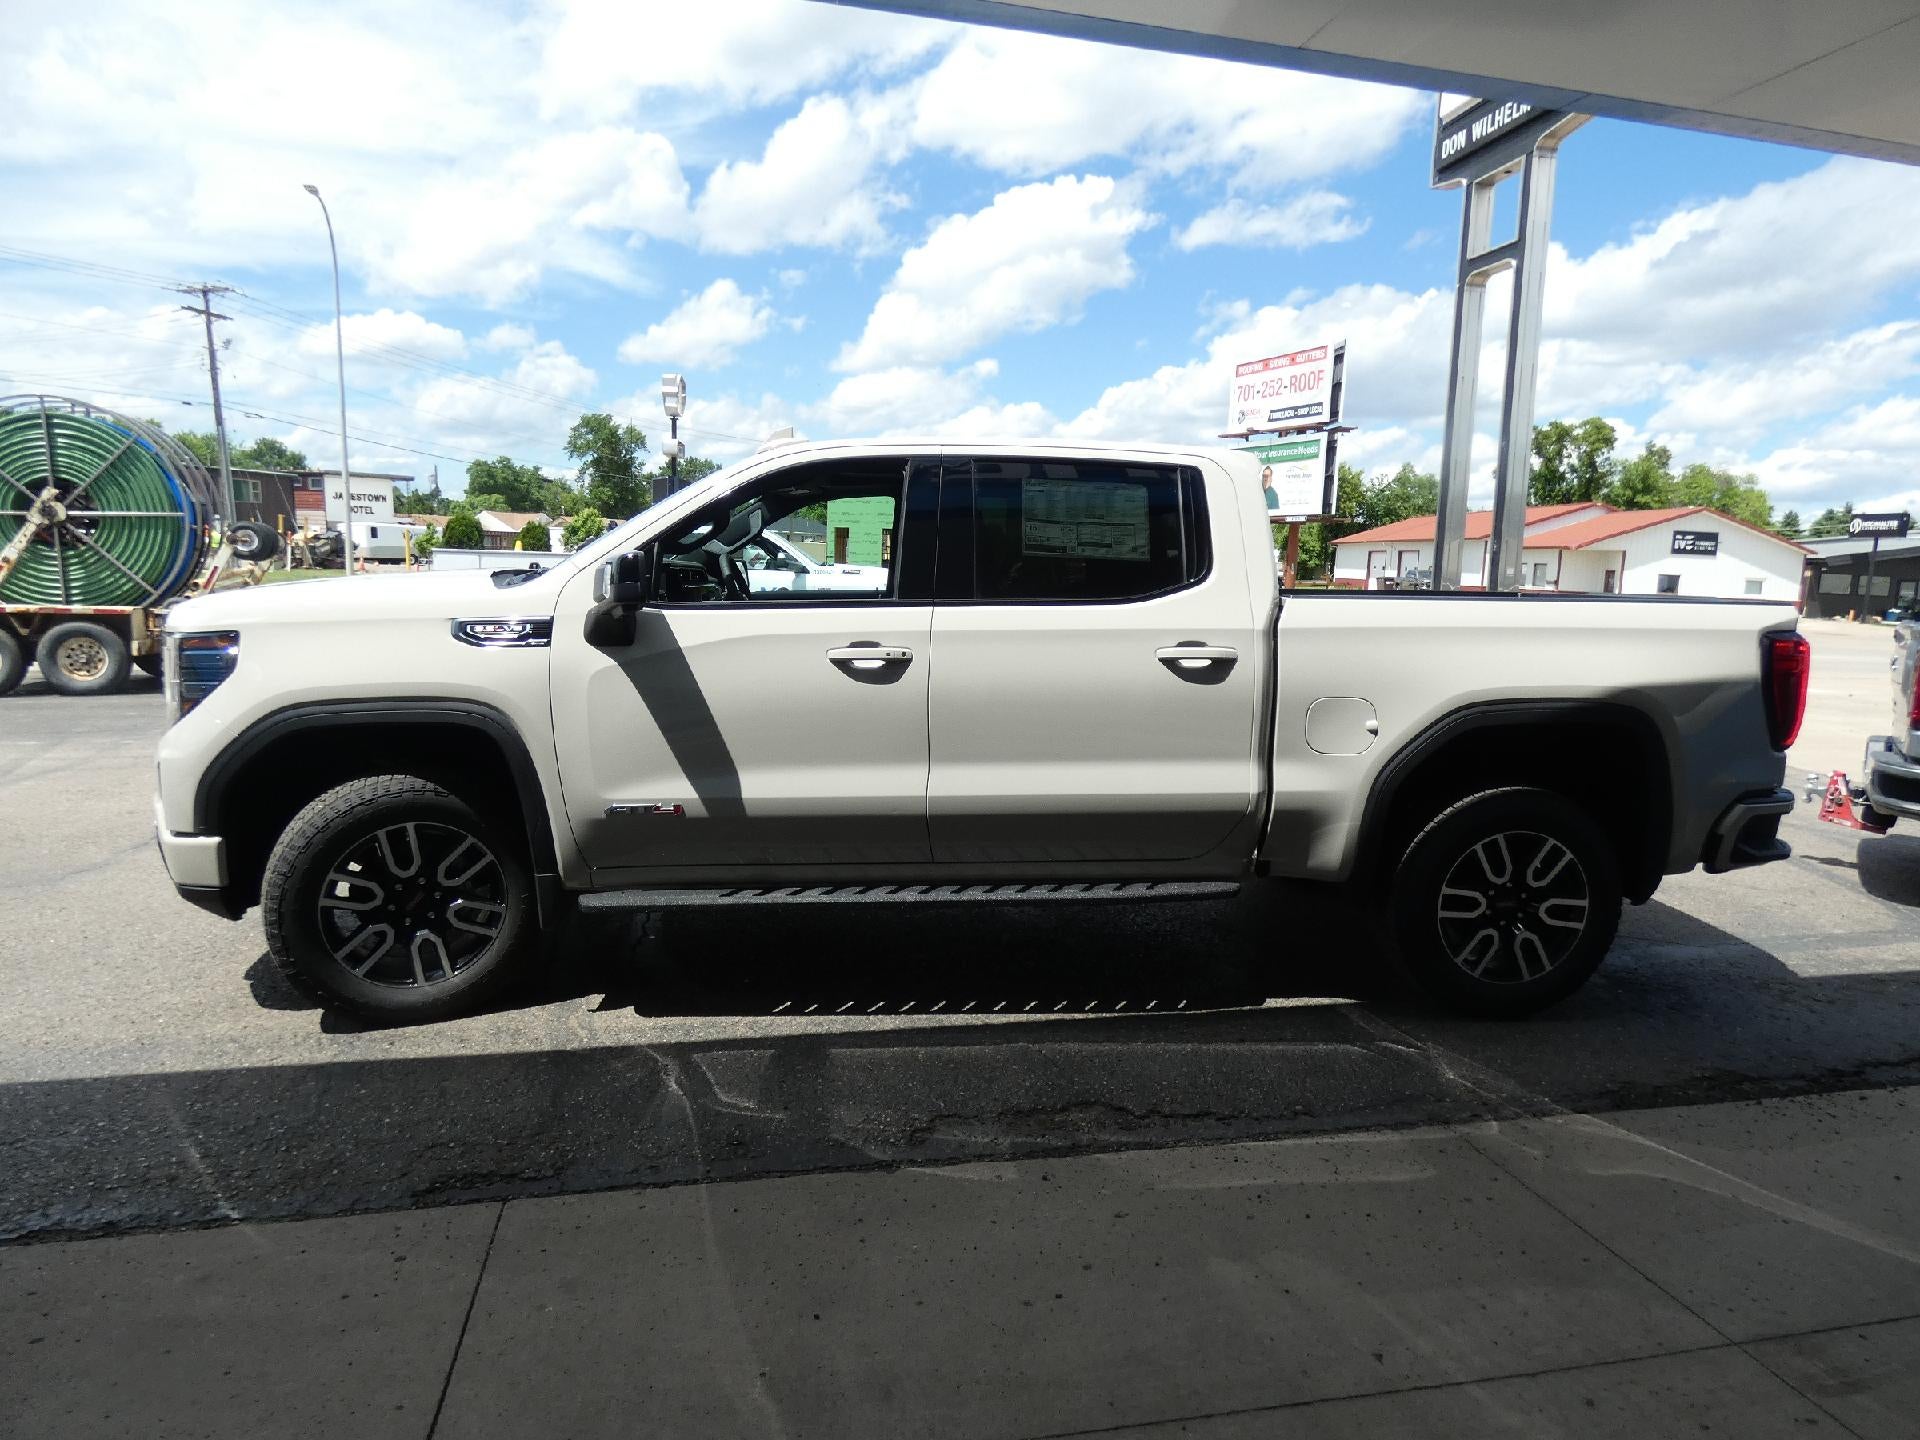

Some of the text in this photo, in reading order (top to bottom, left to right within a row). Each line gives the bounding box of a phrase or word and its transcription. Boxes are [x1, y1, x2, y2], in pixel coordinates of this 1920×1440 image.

[1441, 129, 1467, 159] DON
[1238, 369, 1325, 403] 701-252-ROOF
[332, 491, 387, 502] JAESTOWN
[350, 505, 375, 514] OTEL
